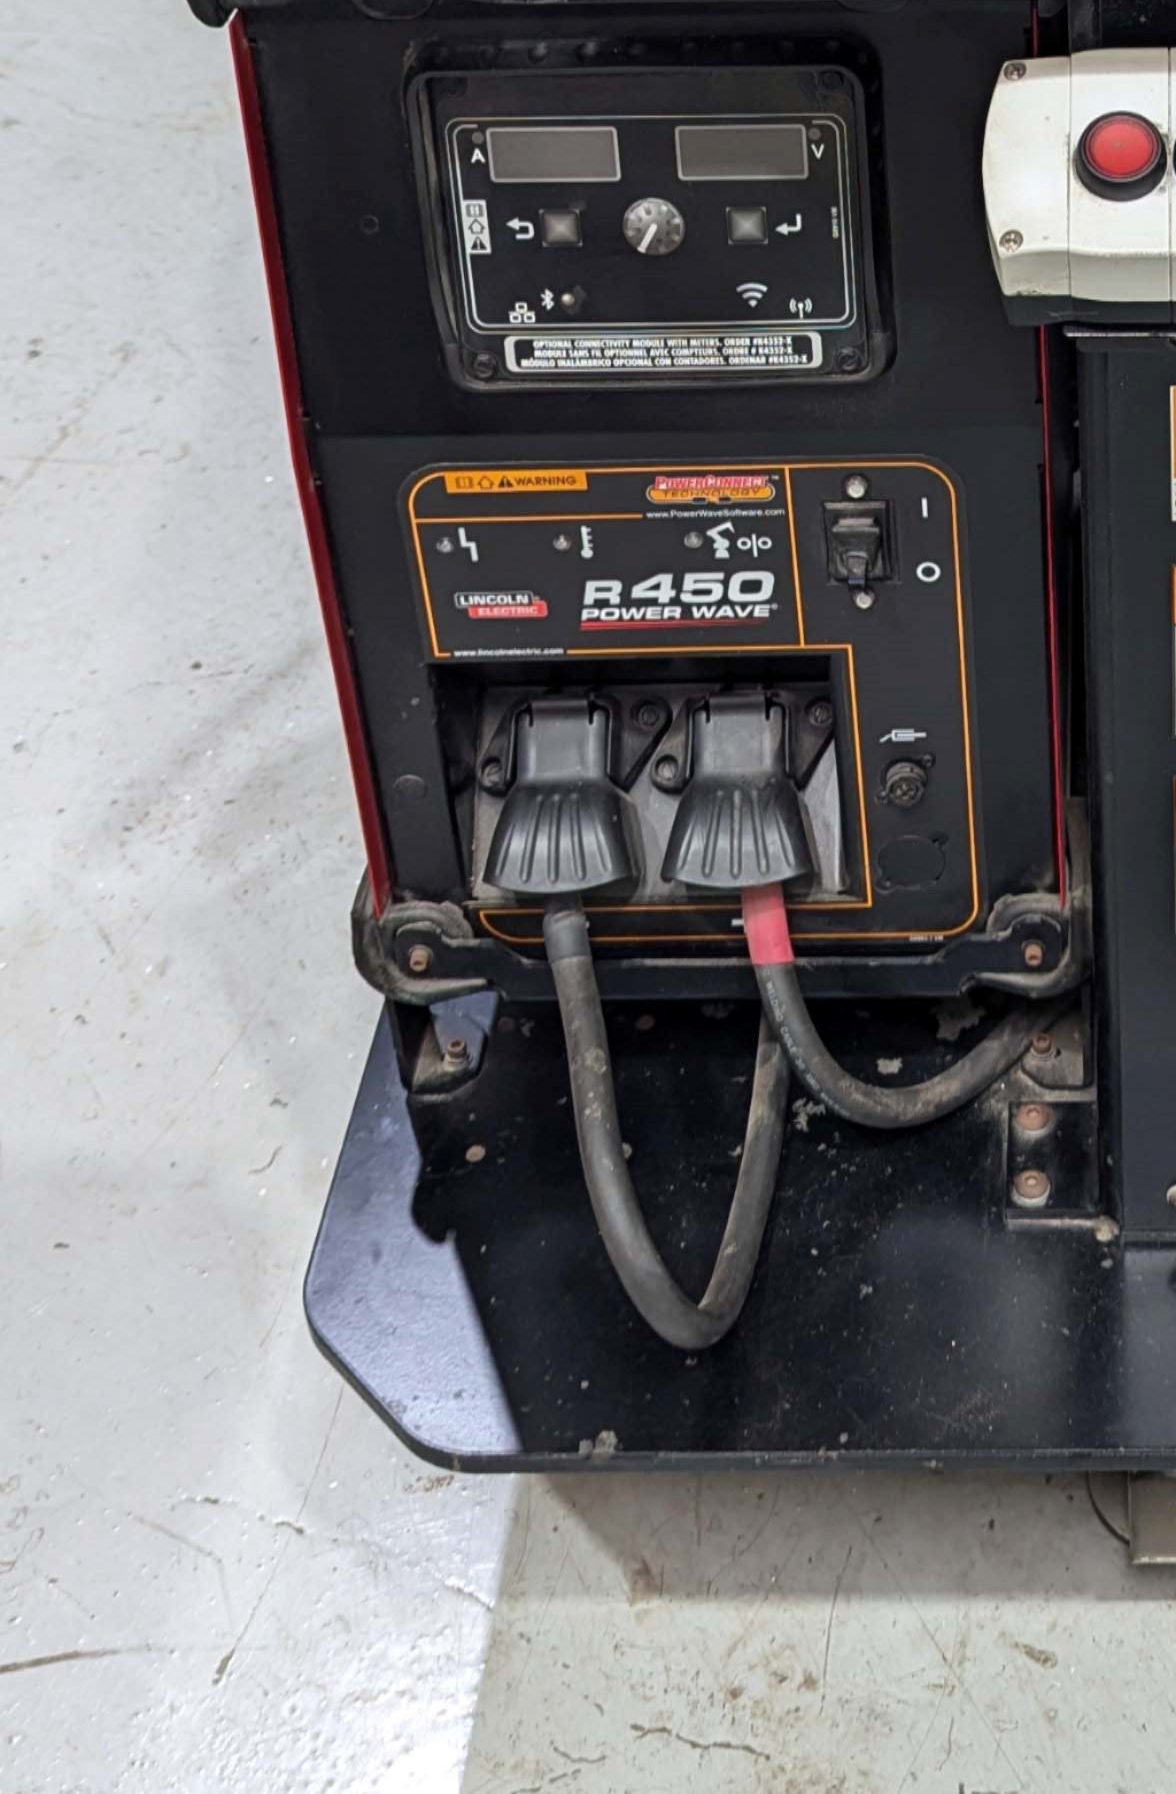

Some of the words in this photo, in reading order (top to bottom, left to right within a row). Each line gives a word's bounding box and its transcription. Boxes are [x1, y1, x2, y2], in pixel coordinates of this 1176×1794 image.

[471, 148, 486, 163] A
[811, 144, 825, 159] V
[533, 339, 572, 348] OPTIONAL
[574, 339, 630, 348] CONNECTIVITY
[633, 339, 664, 348] MODULE
[667, 338, 688, 347] WITH
[724, 337, 750, 346] ORDER
[534, 349, 567, 358] MODULE
[569, 349, 589, 357] SANS
[604, 348, 647, 357] OPTIONNEL
[650, 348, 668, 356] AVEC
[722, 347, 750, 356] ORDRE
[613, 358, 652, 366] OPCIONAL
[655, 358, 671, 366] CON
[729, 356, 766, 365] ORDENAR
[514, 475, 577, 486] WARNING
[663, 489, 760, 498] TECHNOLOGY
[646, 509, 785, 519] www.PowerWaveSoftware.com
[460, 594, 529, 605] LINCOLN
[478, 606, 539, 616] ELECTRIC
[582, 606, 681, 621] POWER
[454, 647, 564, 657] www.lincolnelectric.com
